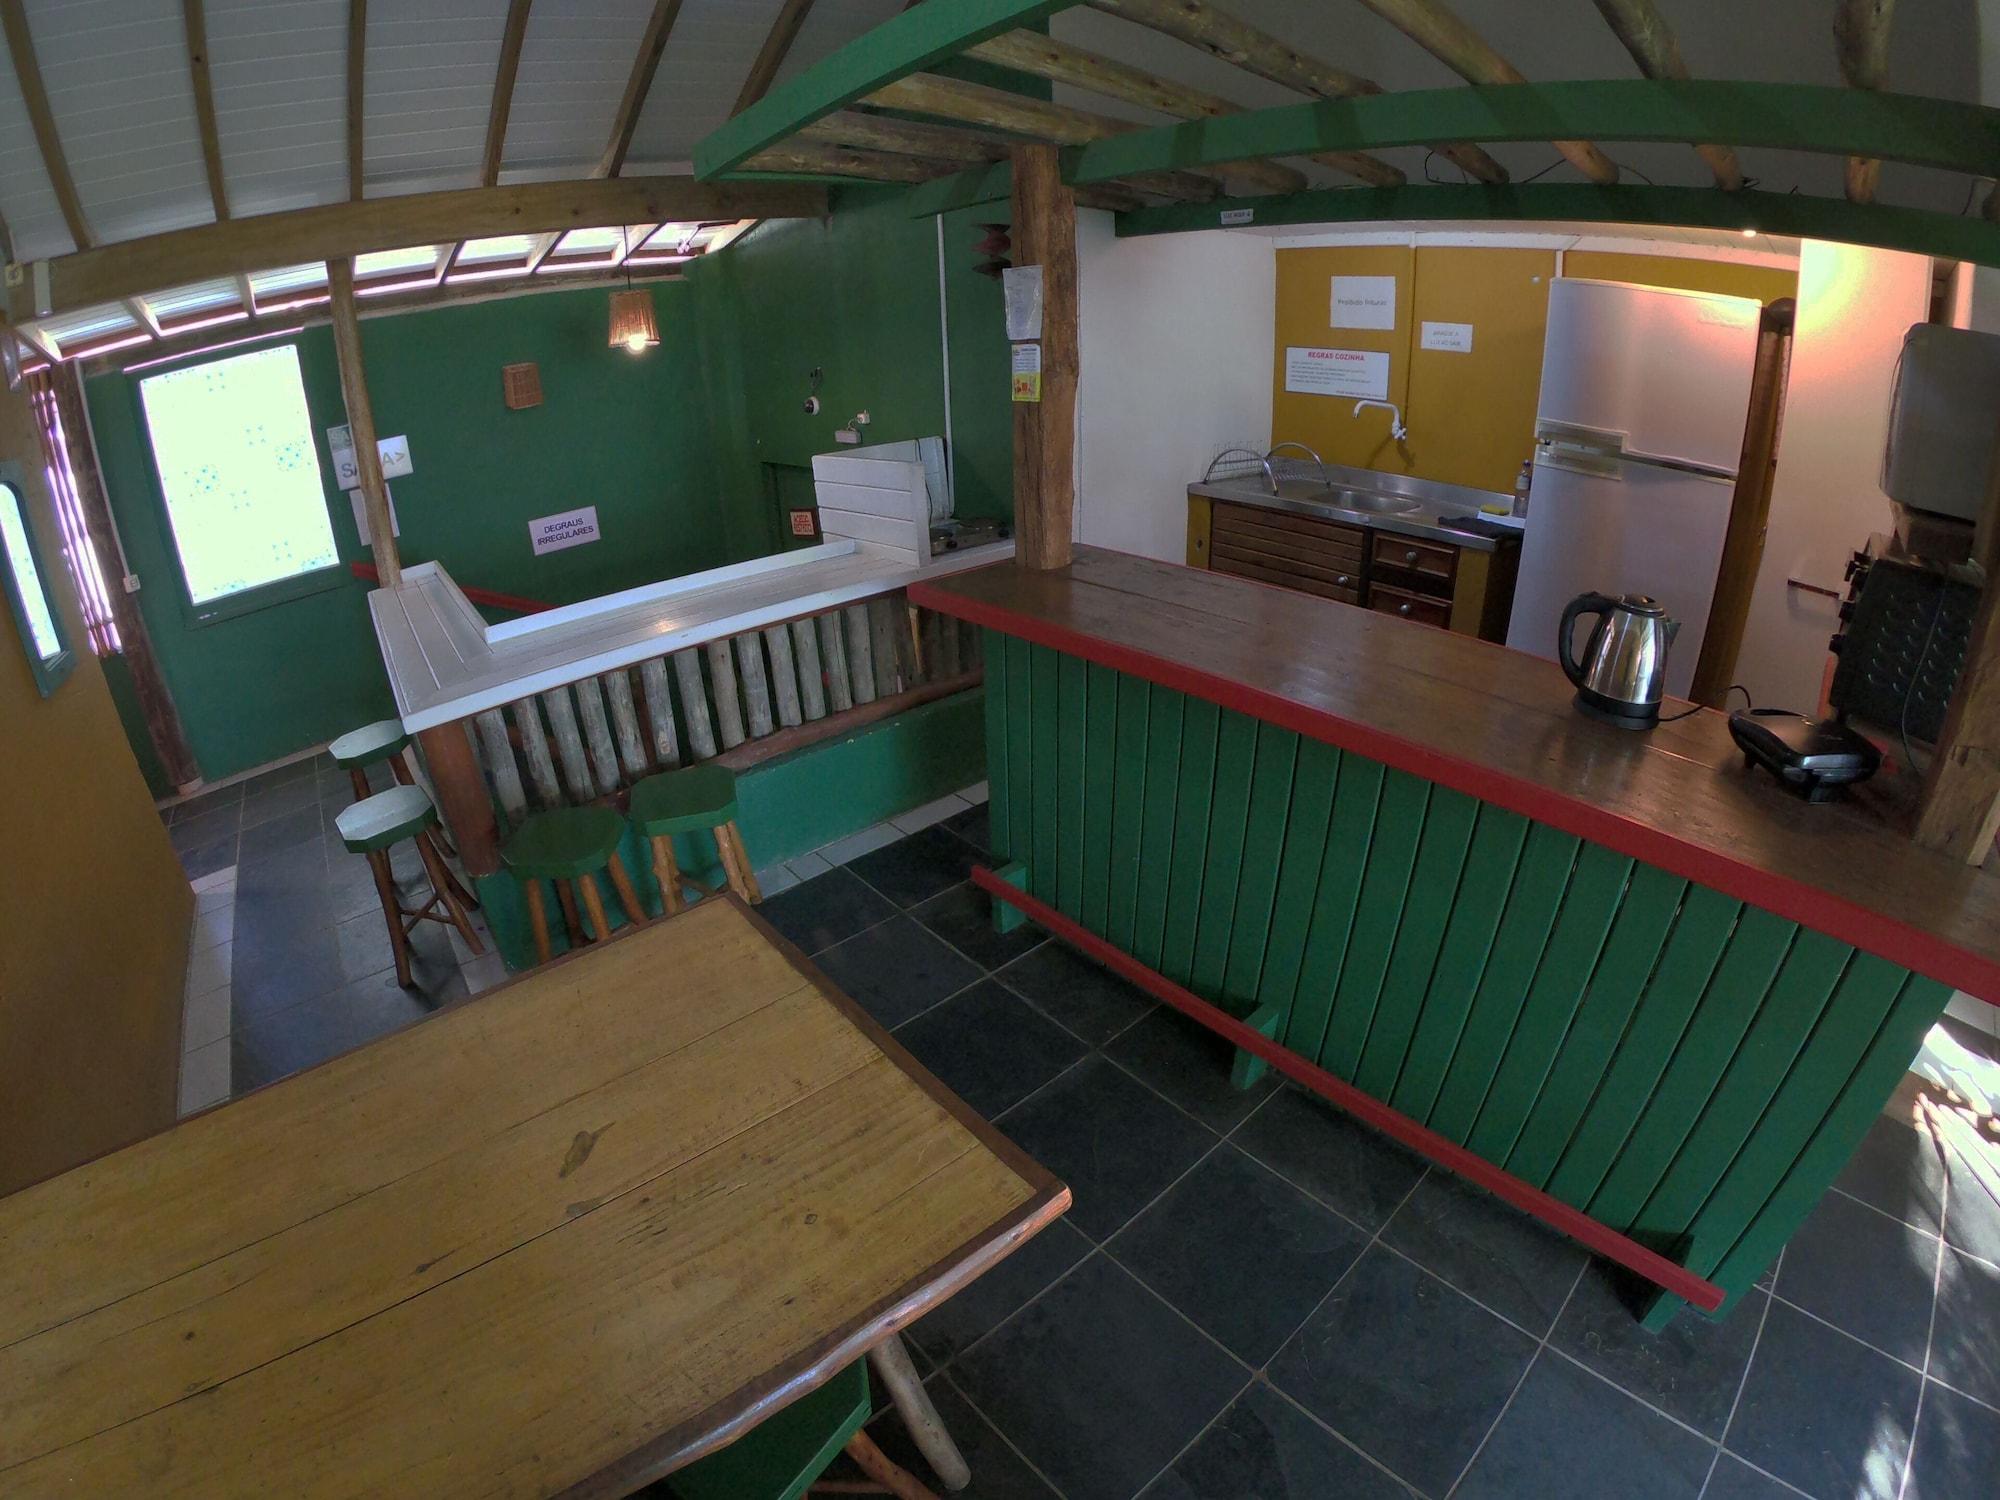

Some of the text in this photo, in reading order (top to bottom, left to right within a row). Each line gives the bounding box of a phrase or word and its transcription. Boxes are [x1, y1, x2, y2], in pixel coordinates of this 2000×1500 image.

[1308, 351, 1365, 361] REGRAS COZINHA
[544, 517, 584, 534] DEGRAUS
[537, 525, 595, 546] IRREGULARES
